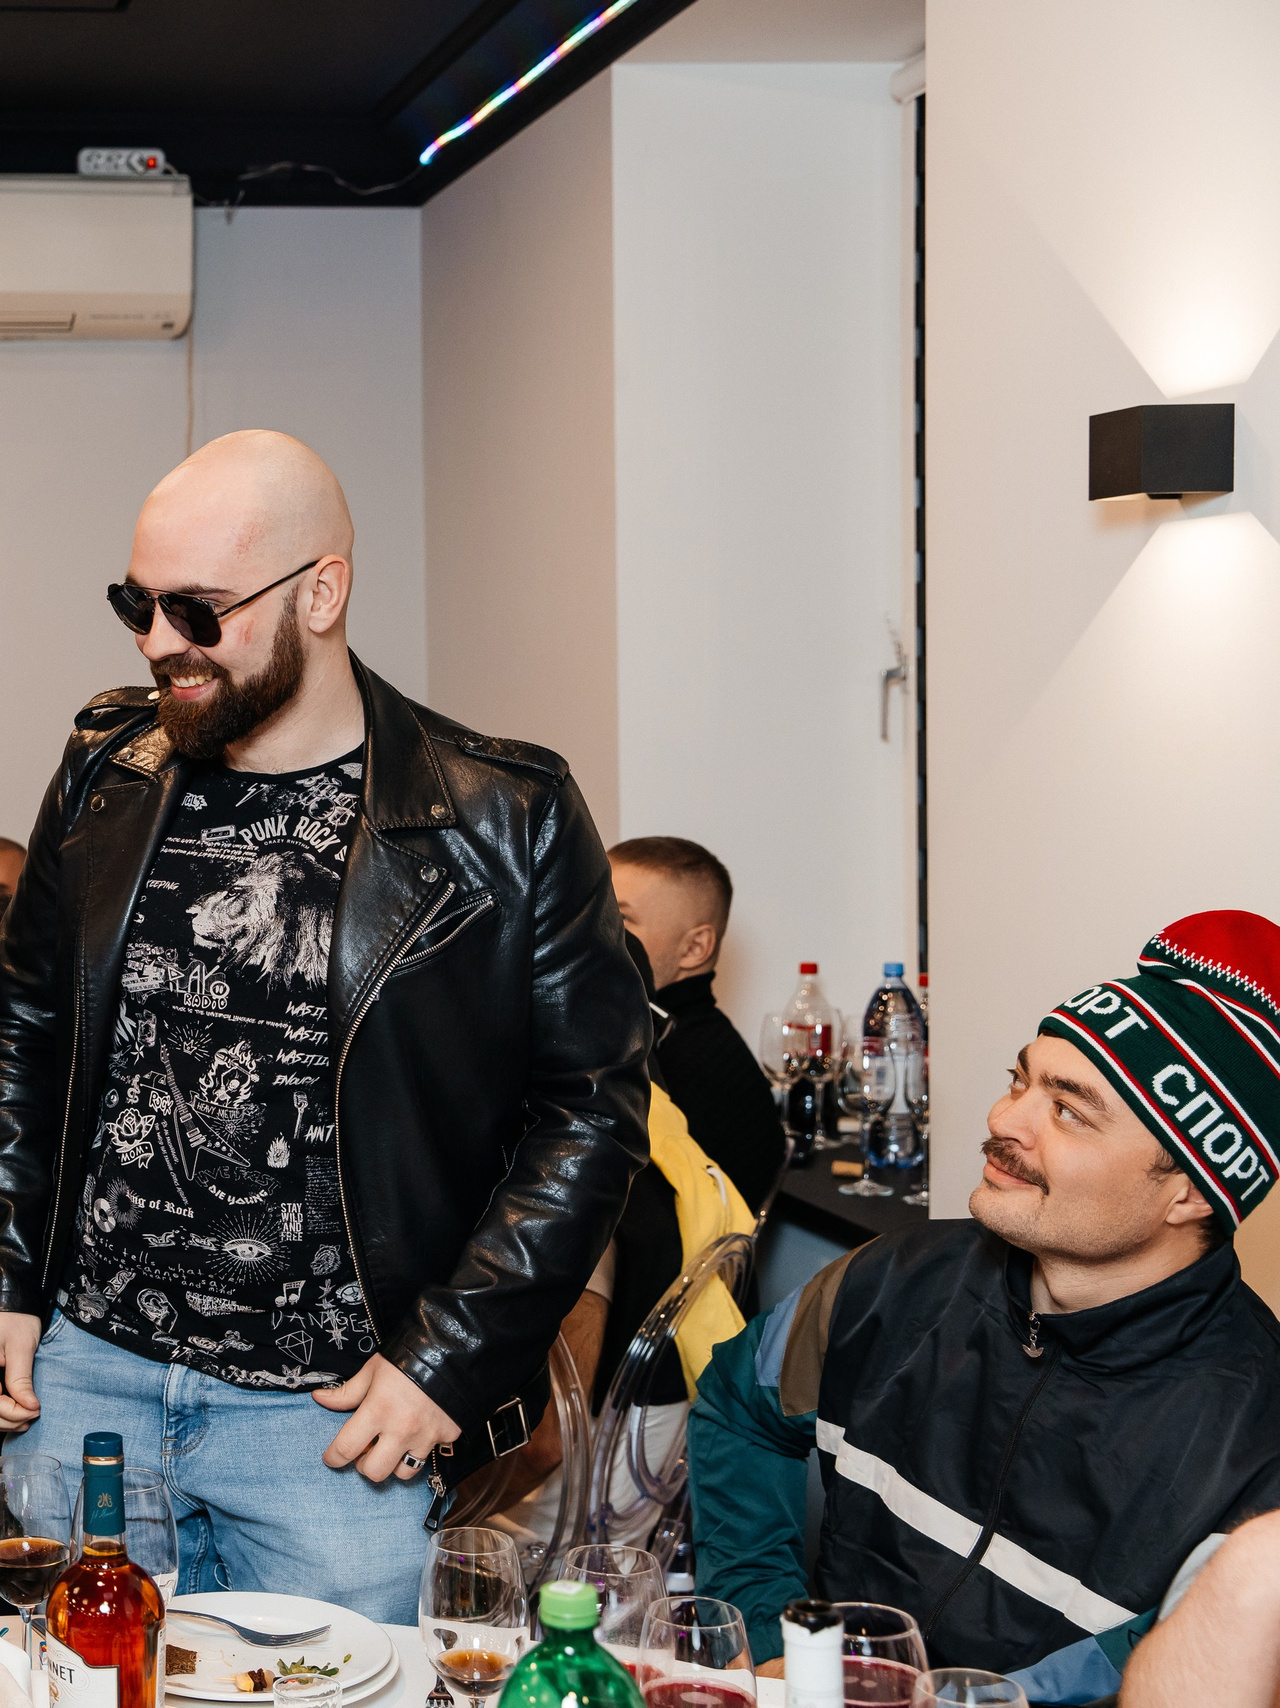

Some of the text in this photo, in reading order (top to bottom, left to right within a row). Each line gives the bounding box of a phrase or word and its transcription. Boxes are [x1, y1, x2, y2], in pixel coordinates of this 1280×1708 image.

[239, 815, 341, 853] PUNK ROCK
[285, 1001, 314, 1017] WAS
[284, 1025, 313, 1042] WAS
[276, 1048, 305, 1065] WAS
[149, 1091, 173, 1116] ROCK
[197, 1102, 216, 1115] HEAVY
[1152, 1064, 1270, 1202] СПОРТ
[121, 1146, 145, 1163] MOM
[208, 1184, 269, 1206] DIE YOUNG
[149, 1200, 161, 1210] of
[163, 1201, 195, 1219] Rock
[280, 1203, 302, 1213] STAY
[281, 1213, 304, 1222] WILD
[282, 1222, 302, 1232] AND
[280, 1232, 303, 1242] FREE
[122, 1247, 156, 1266] tells
